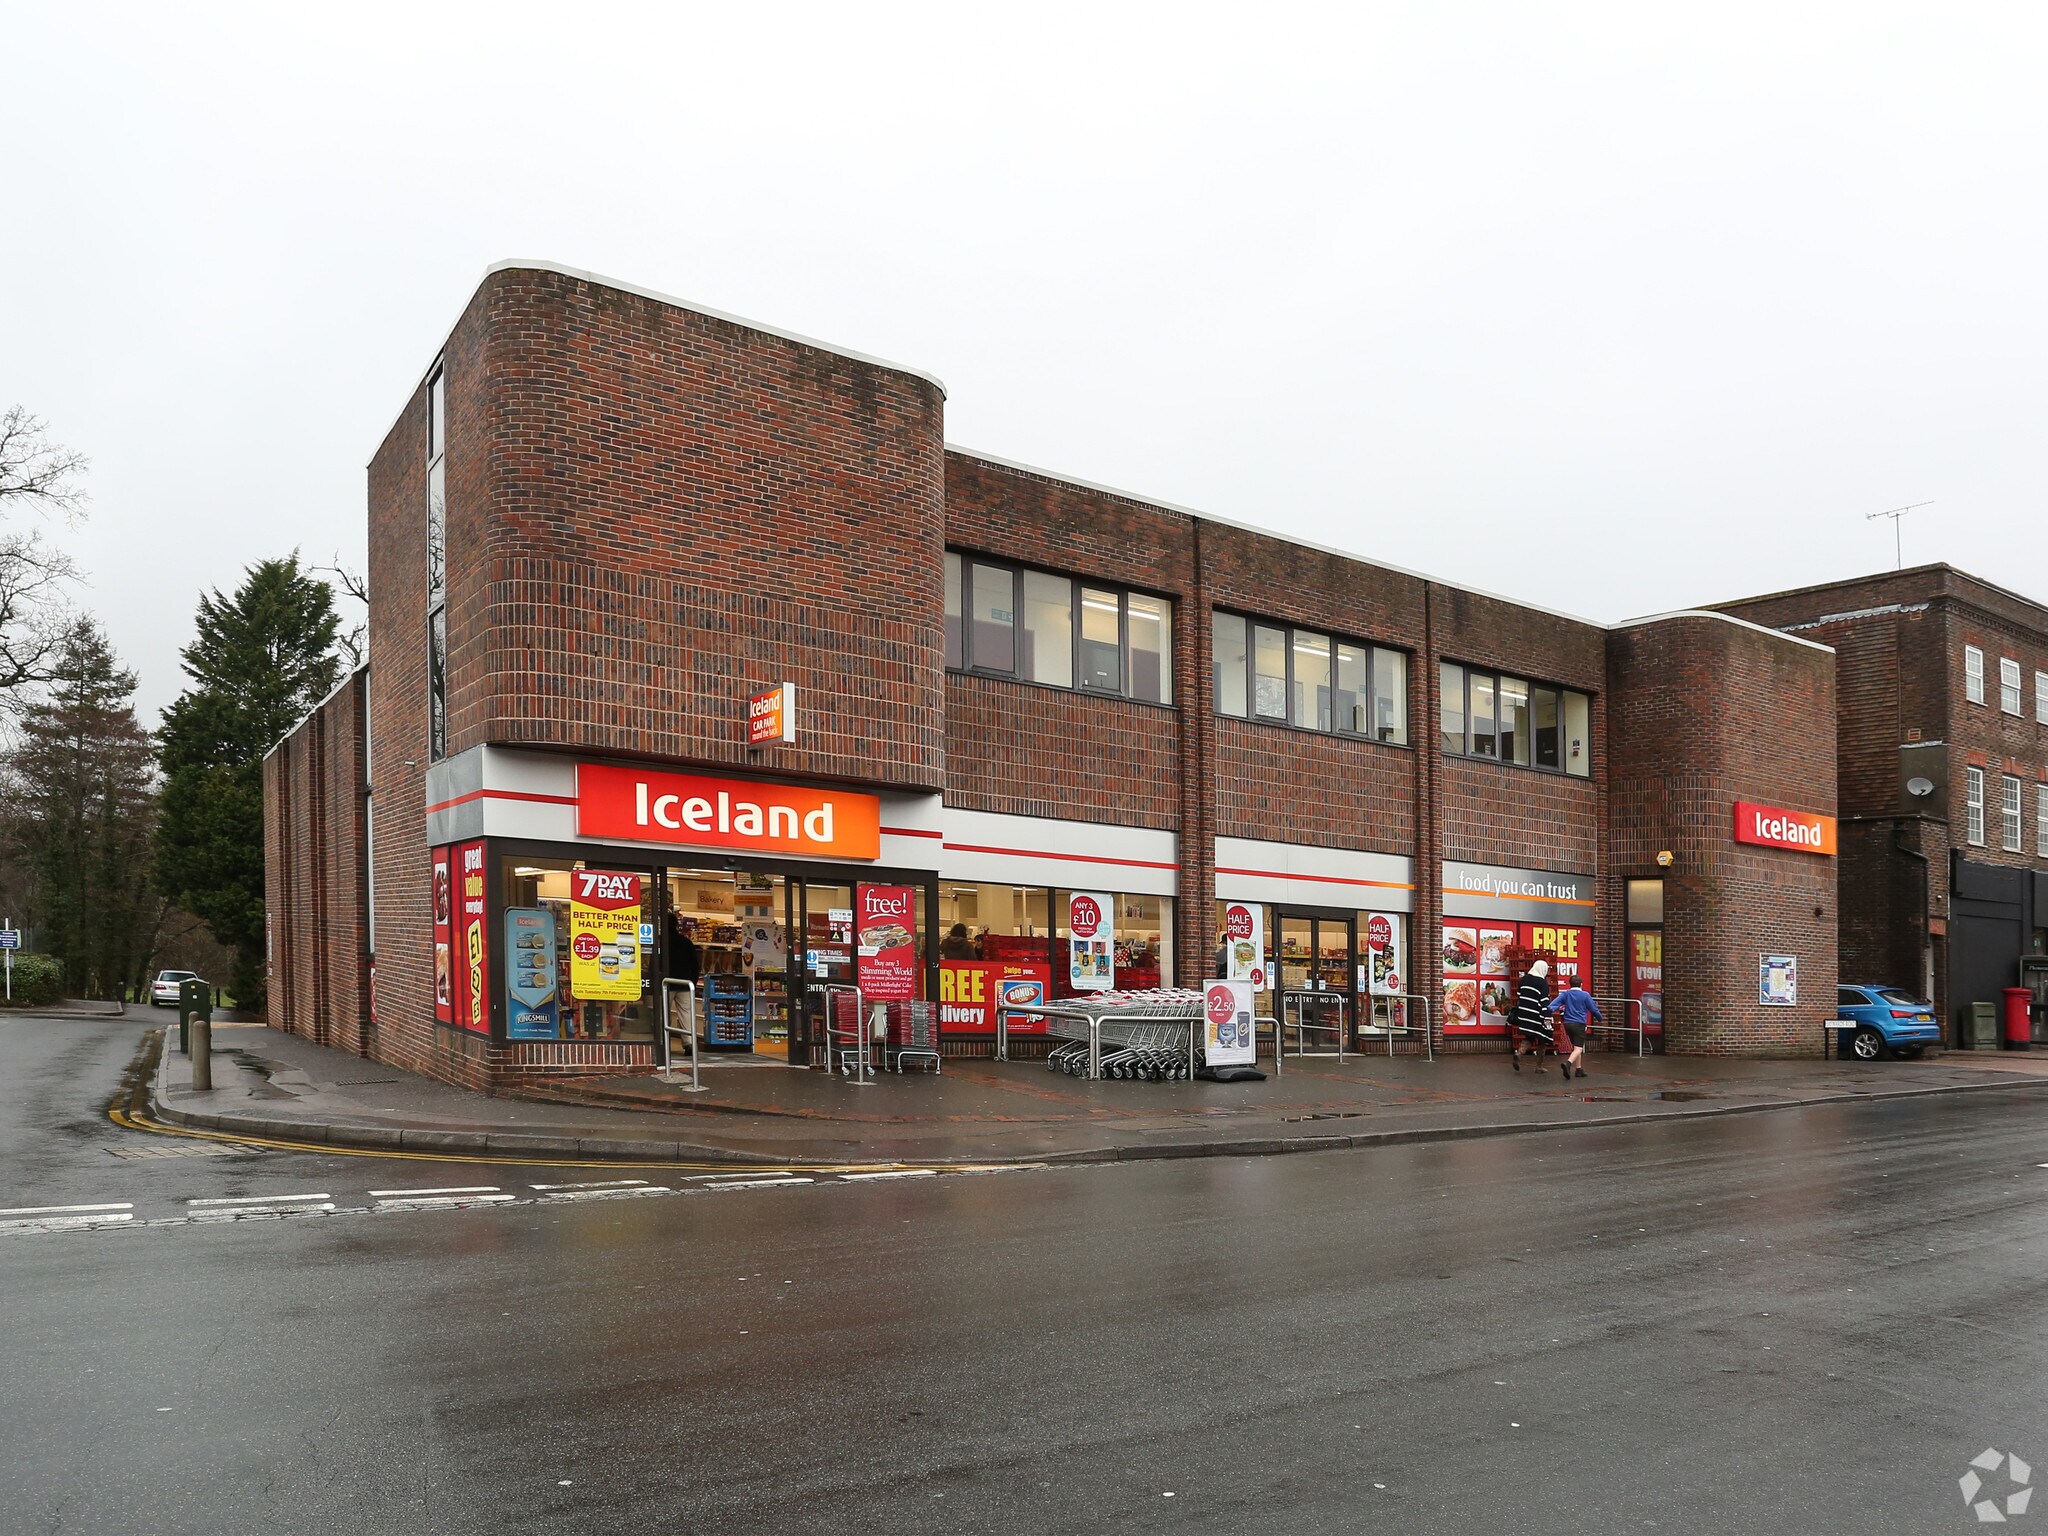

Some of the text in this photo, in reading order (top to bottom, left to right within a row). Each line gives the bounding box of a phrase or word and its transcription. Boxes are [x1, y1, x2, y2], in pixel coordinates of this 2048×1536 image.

[750, 692, 780, 718] Iceland
[753, 716, 776, 731] CAR PARK
[752, 730, 763, 740] round
[769, 726, 778, 736] back
[636, 783, 834, 843] Iceland
[1755, 812, 1821, 847] Iceland
[465, 846, 482, 873] great
[465, 873, 483, 898] value
[579, 874, 632, 897] 7 DAY
[1459, 871, 1577, 900] food you can trust
[598, 888, 633, 900] DEAL
[466, 900, 484, 915] everyday!
[865, 889, 907, 914] free!
[1075, 902, 1089, 910] ANY
[573, 912, 638, 922] BETTER THAN
[1073, 910, 1096, 926] £10
[1227, 914, 1250, 925] HALF
[578, 921, 634, 931] HALF PRICE
[1228, 925, 1250, 935] PRICE
[1370, 924, 1390, 933] HALF
[1370, 934, 1389, 943] PRICE
[575, 941, 600, 954] £1.39
[874, 959, 885, 967] Buy
[860, 966, 913, 977] Slimming World
[1004, 966, 1022, 975] Swipe
[940, 969, 989, 1003] REE
[1010, 987, 1035, 1001] BONUS
[1209, 996, 1234, 1012] £2.50
[517, 1014, 549, 1024] KINGSMILL
[940, 1005, 985, 1025] livery
